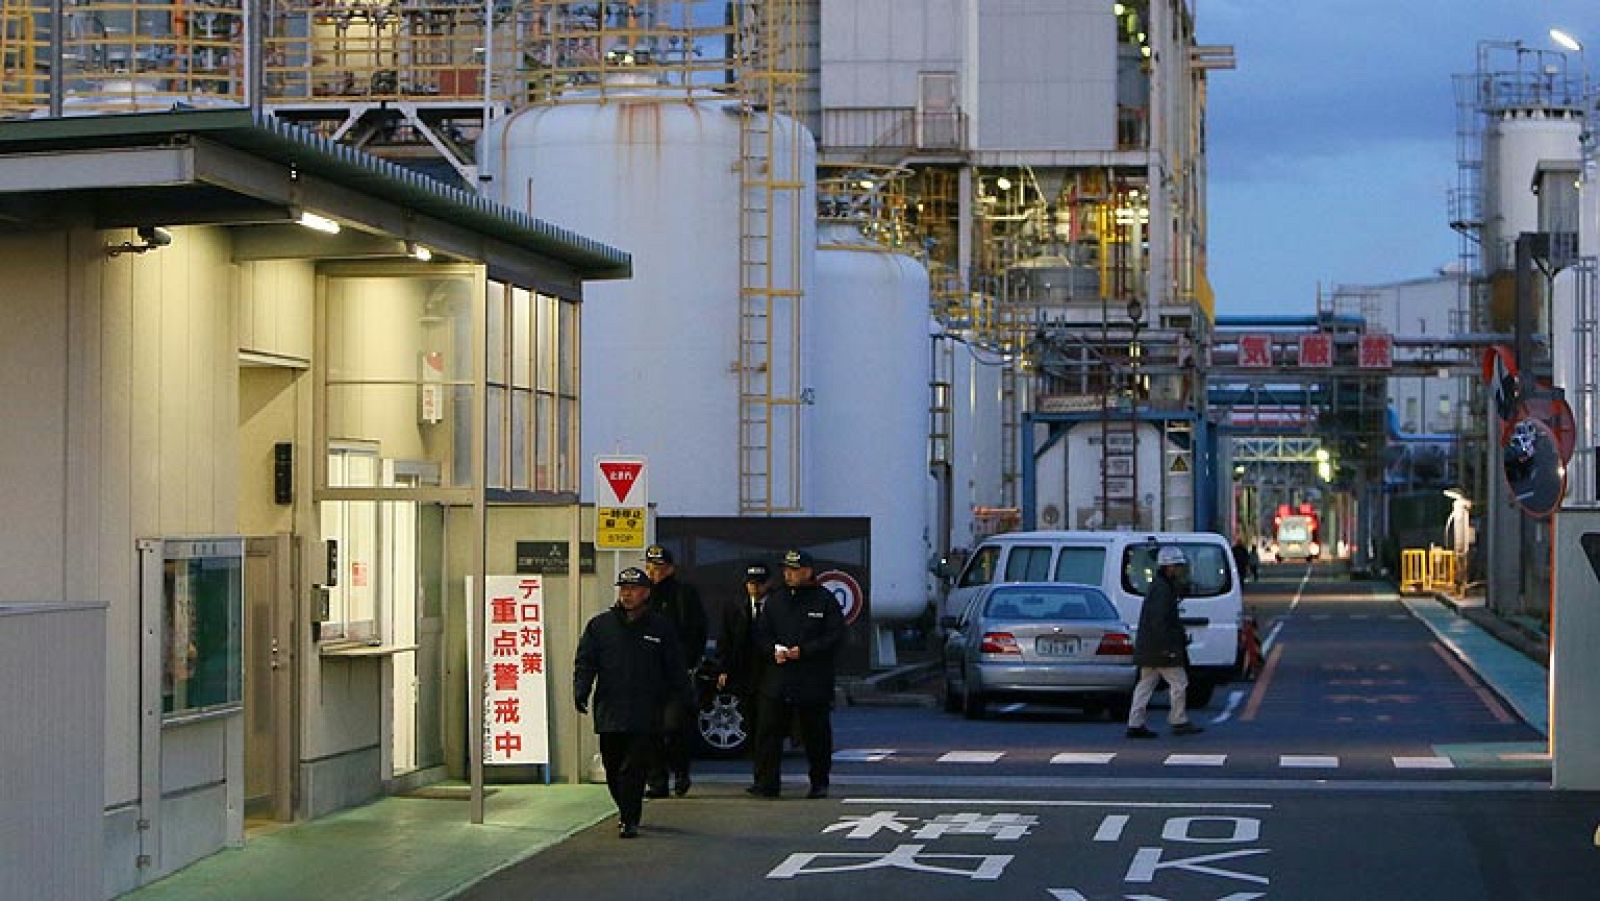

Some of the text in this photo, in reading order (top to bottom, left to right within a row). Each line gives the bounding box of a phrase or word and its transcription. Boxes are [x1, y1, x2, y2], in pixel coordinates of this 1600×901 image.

[491, 597, 522, 758] 重点警戒中
[519, 579, 543, 675] テロ対策
